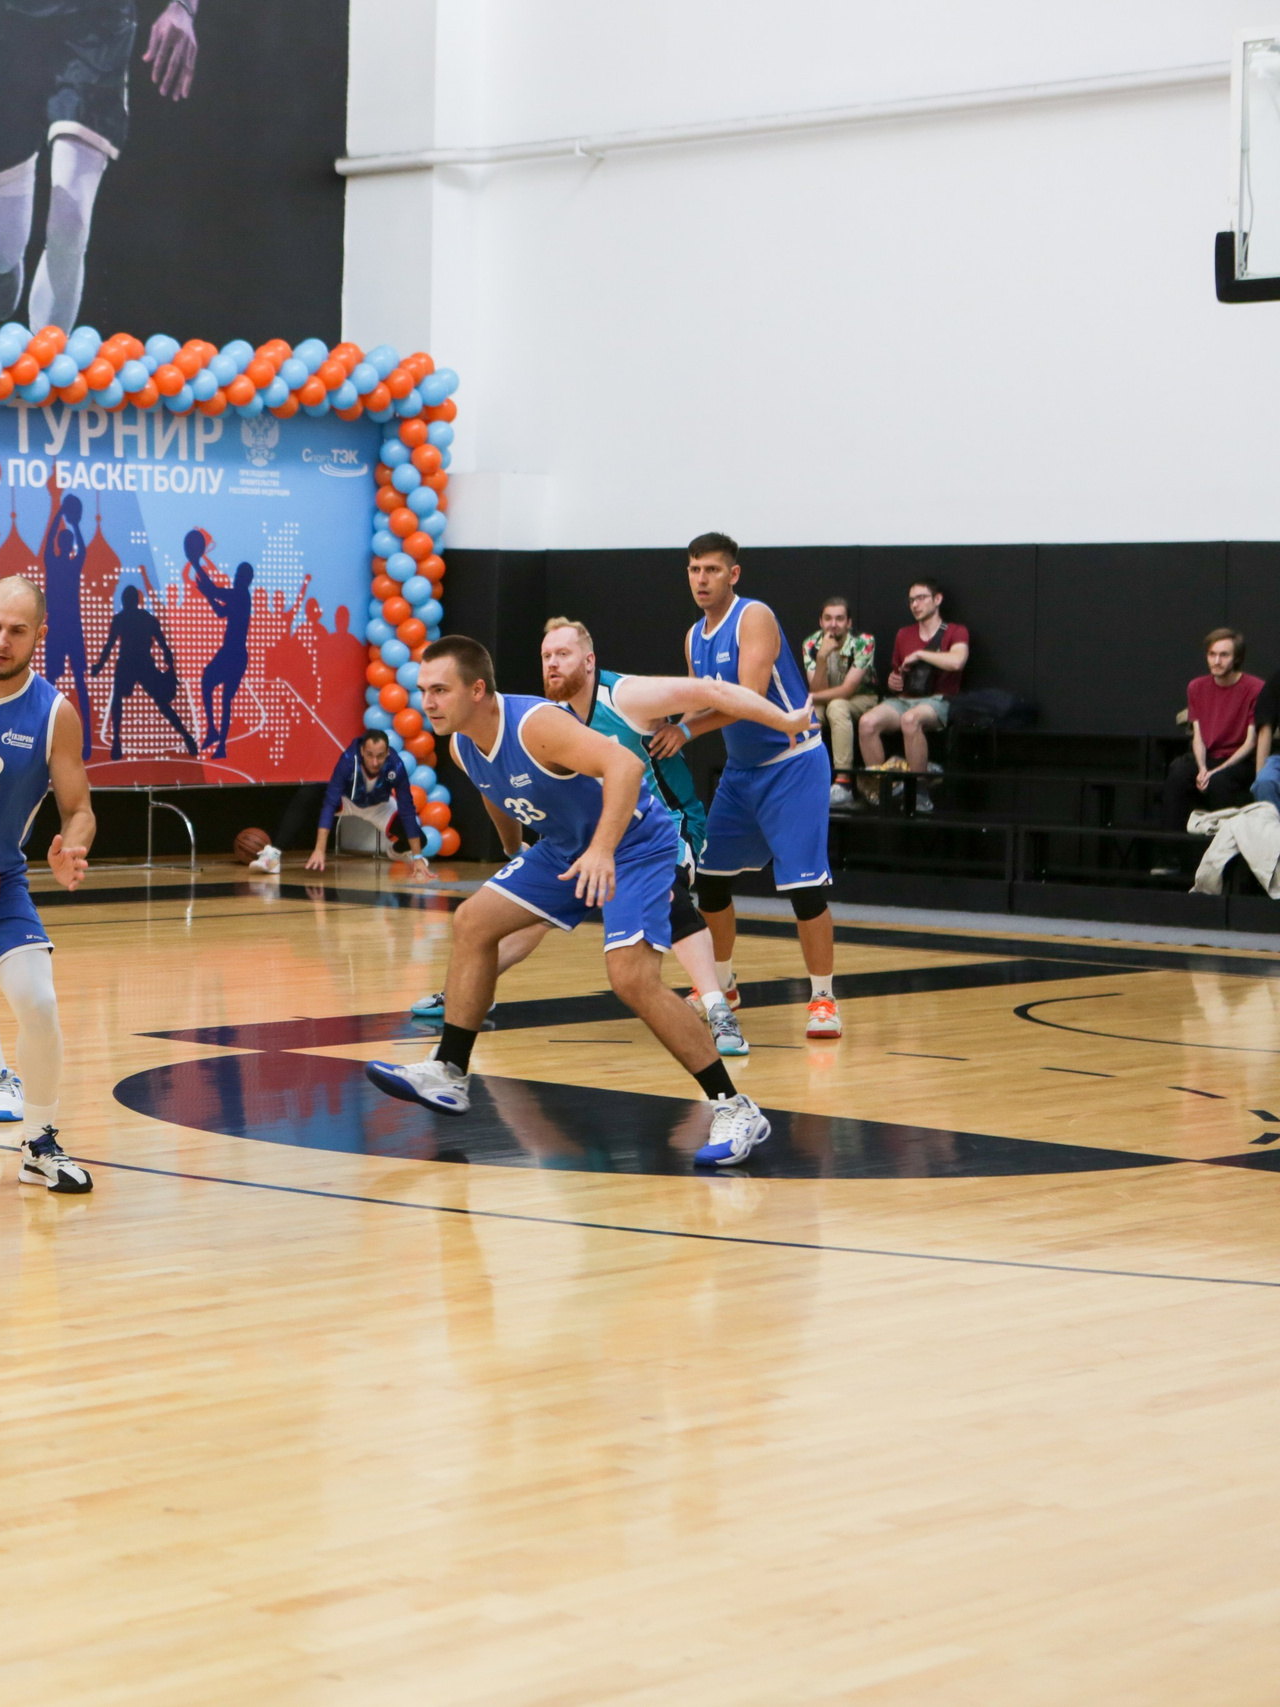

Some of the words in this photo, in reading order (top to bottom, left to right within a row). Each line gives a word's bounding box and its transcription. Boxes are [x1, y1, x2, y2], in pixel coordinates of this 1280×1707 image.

[7, 397, 223, 462] ТУРНИР
[8, 458, 48, 488] ПО
[55, 460, 224, 495] БАСКЕТБОЛУ
[504, 797, 547, 825] 33
